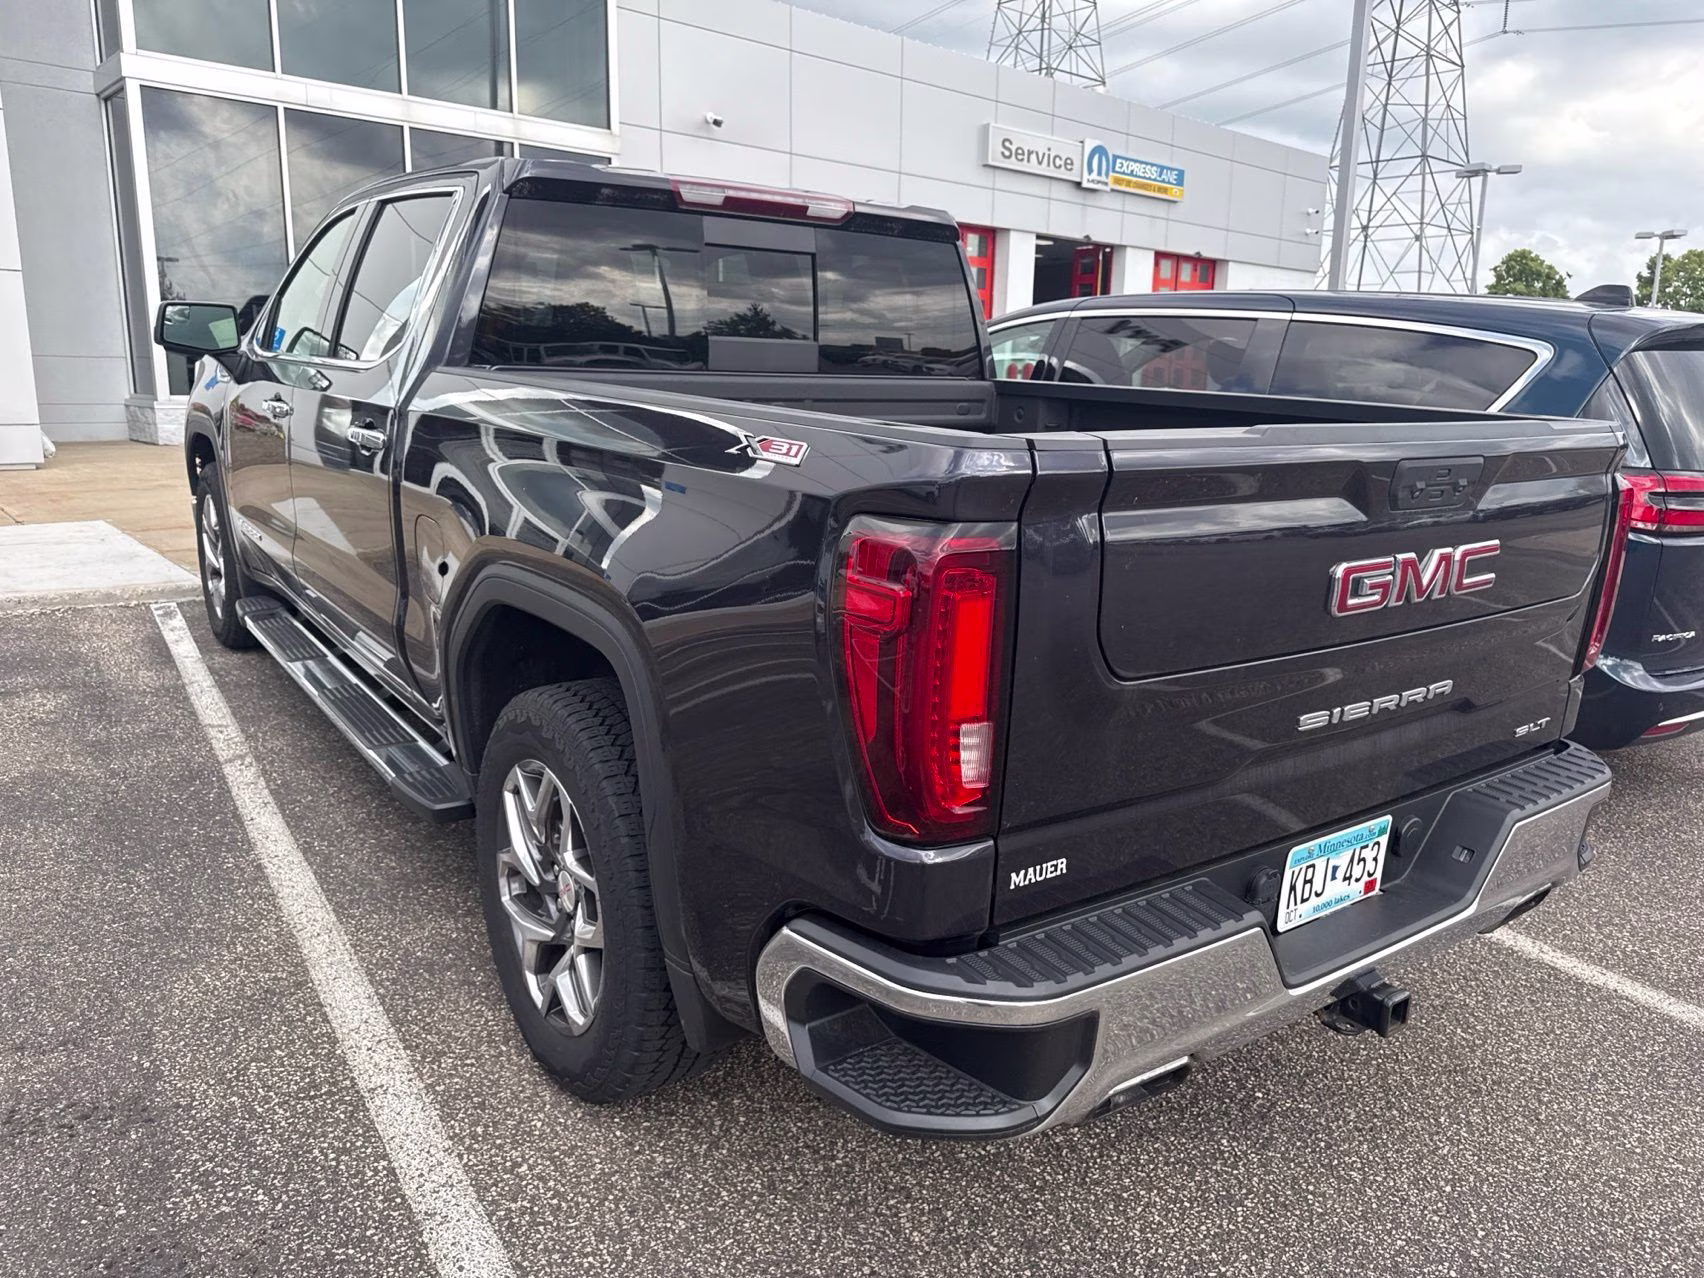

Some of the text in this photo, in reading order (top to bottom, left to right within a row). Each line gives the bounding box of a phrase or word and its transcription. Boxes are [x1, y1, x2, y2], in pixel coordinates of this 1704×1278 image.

[1001, 138, 1074, 172] Service
[1329, 539, 1500, 618] GMC
[1298, 679, 1453, 731] SIERRA
[1513, 717, 1551, 738] SLT
[1009, 857, 1067, 890] MAUER
[1286, 840, 1381, 910] KBJ 453
[1284, 908, 1298, 925] OCT
